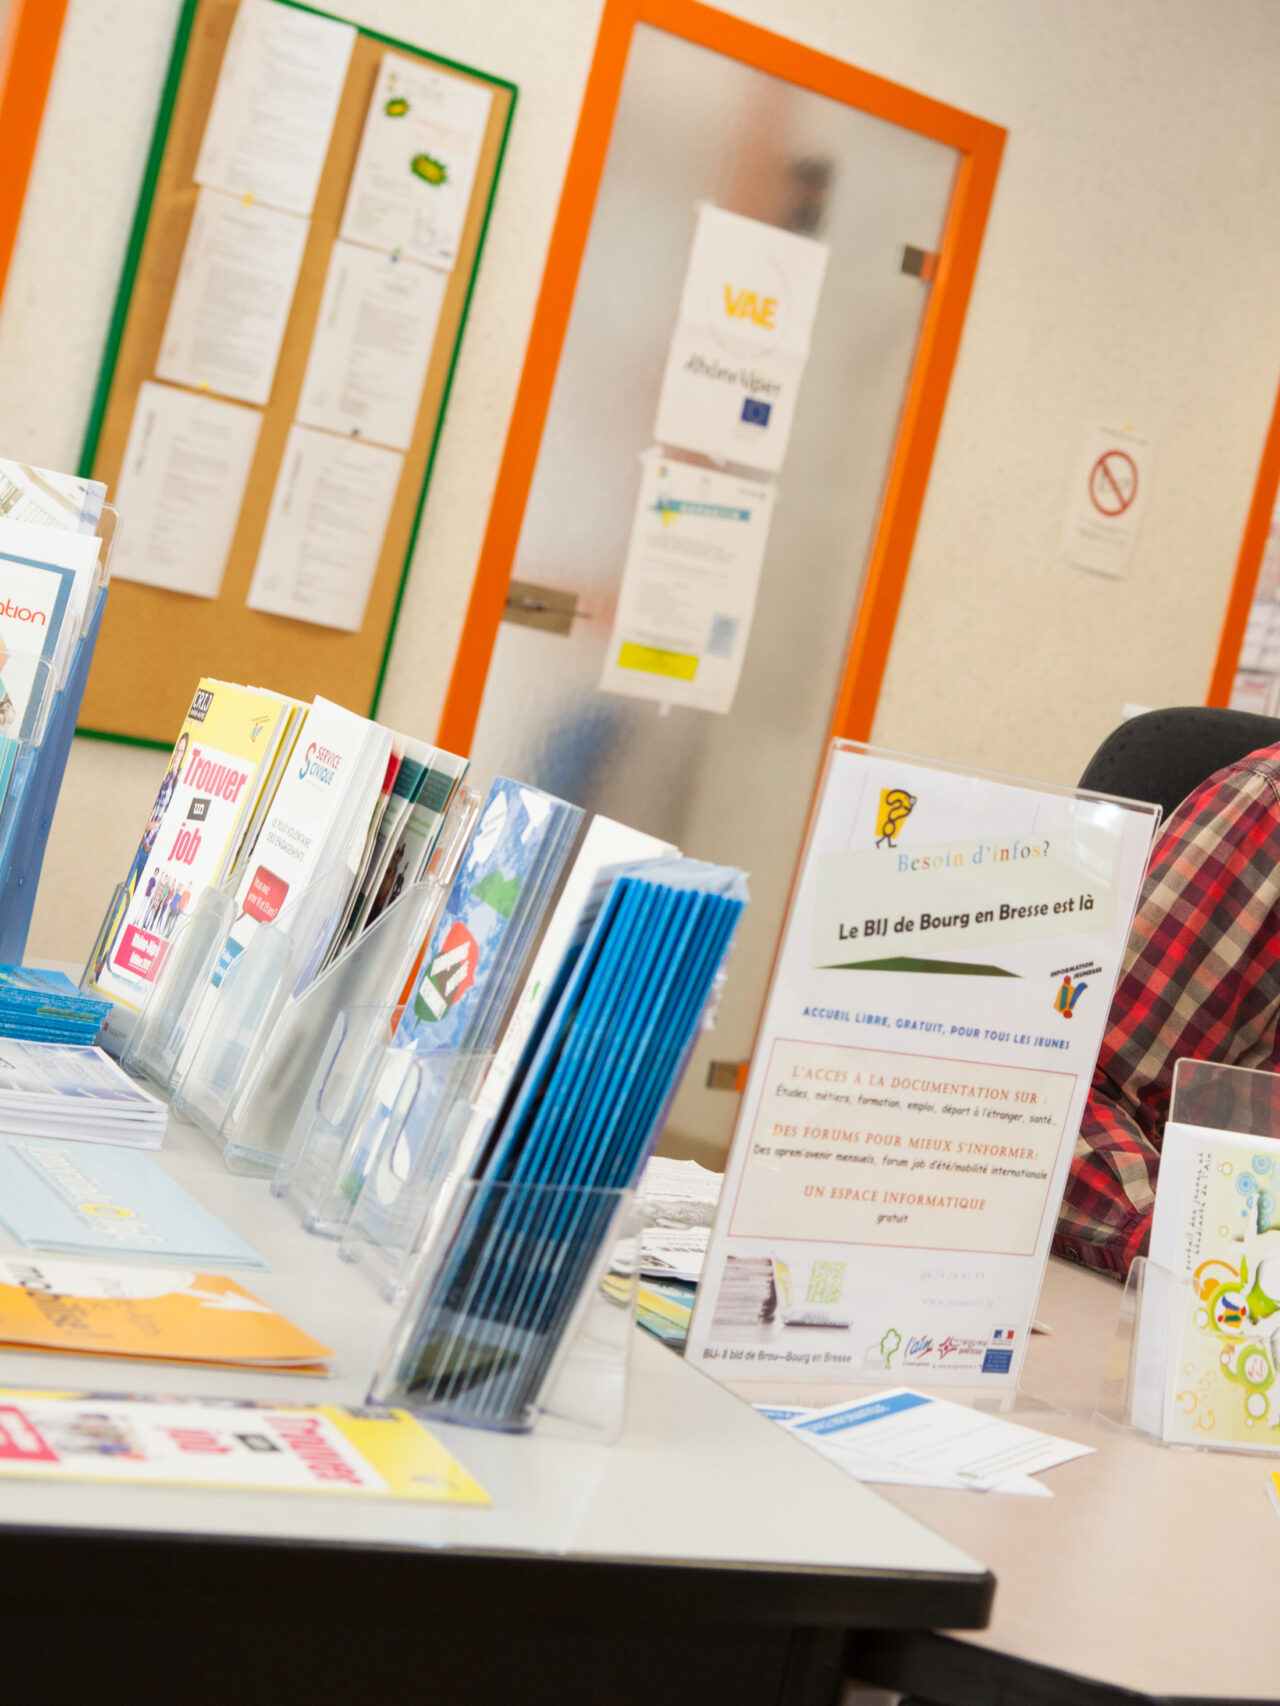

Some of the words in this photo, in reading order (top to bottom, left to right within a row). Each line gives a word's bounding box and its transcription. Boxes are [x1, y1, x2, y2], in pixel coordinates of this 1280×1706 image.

[723, 283, 779, 330] VAE
[193, 690, 214, 712] CRIJ
[316, 746, 342, 770] SERVICE
[183, 748, 249, 804] Trouver
[309, 761, 335, 786] CIVIQUE
[193, 803, 205, 815] un
[167, 822, 202, 866] job
[897, 852, 965, 874] Besoin
[972, 840, 1051, 865] d'infos?
[838, 922, 859, 942] Le
[863, 917, 890, 938] BIJ
[893, 914, 915, 934] de
[919, 909, 970, 933] Bourg
[975, 908, 995, 925] en
[999, 902, 1050, 922] Bresse
[1053, 898, 1076, 914] est
[1078, 894, 1095, 912] là
[1050, 960, 1095, 977] INFORMATION
[1073, 967, 1103, 980] JEUNESSE
[802, 1006, 851, 1022] ACCUEIL
[855, 1012, 892, 1028] LIBRE,
[895, 1018, 946, 1035] GRATUIT,
[950, 1025, 981, 1039] POUR
[984, 1029, 1010, 1043] TOUS
[1013, 1033, 1031, 1046] LES
[1033, 1036, 1070, 1050] JEUNES
[791, 1065, 848, 1084] L'ACCES
[867, 1073, 885, 1087] LA
[890, 1076, 1010, 1101] DOCUMENTATION
[1013, 1090, 1038, 1105] SUR
[815, 1090, 852, 1105] métiers,
[857, 1094, 902, 1109] formation,
[906, 1100, 937, 1115] emploi,
[942, 1103, 970, 1118] départ
[772, 1123, 798, 1139] DES
[802, 1126, 861, 1145] FORUMS
[865, 1131, 902, 1147] POUR
[908, 1136, 953, 1153] MIEUX
[957, 1141, 1039, 1160] S'INFORMER:
[753, 1143, 771, 1155] Des
[836, 1153, 878, 1166] mensuels,
[881, 1155, 909, 1167] forum
[911, 1158, 926, 1171] job
[991, 1167, 1048, 1180] internationale
[803, 1184, 824, 1198] UN
[829, 1186, 878, 1204] ESPACE
[882, 1191, 987, 1211] INFORMATIQUE
[876, 1212, 909, 1226] gratuit
[745, 1350, 756, 1361] de
[823, 1351, 853, 1364] Bresse
